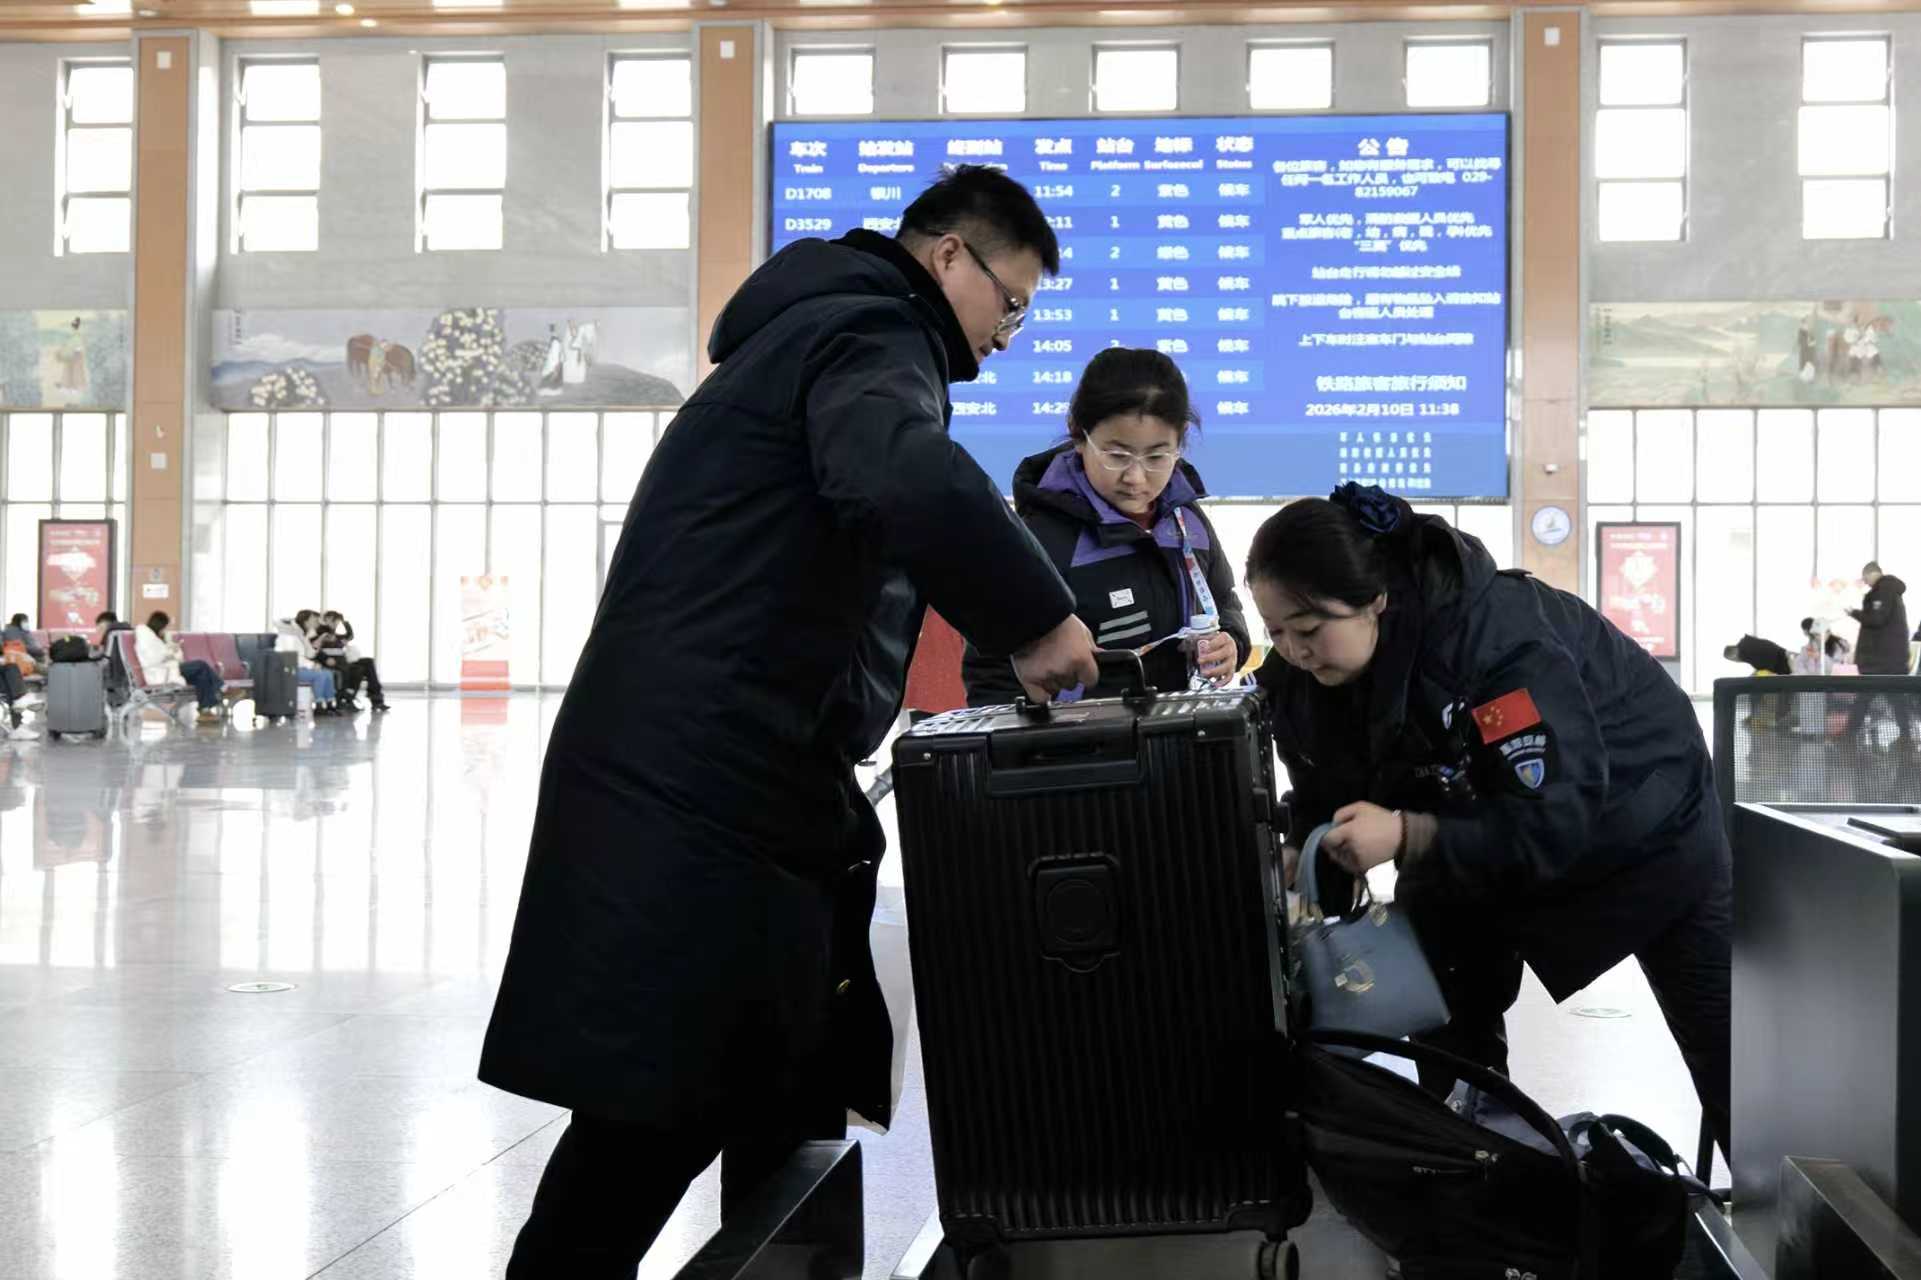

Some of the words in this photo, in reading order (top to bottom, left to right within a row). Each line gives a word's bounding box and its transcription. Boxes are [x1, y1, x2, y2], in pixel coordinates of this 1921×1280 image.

[1040, 162, 1067, 170] Time
[786, 188, 831, 199] D1708
[1036, 186, 1072, 197] 11:54
[1112, 185, 1120, 196] 2
[786, 219, 831, 230] D3529
[1112, 216, 1119, 227] 1
[1111, 247, 1119, 258] 2
[1111, 279, 1118, 289] 1
[1035, 310, 1072, 320] 13:53
[1111, 310, 1118, 320] 1
[1034, 340, 1072, 352] 14:05
